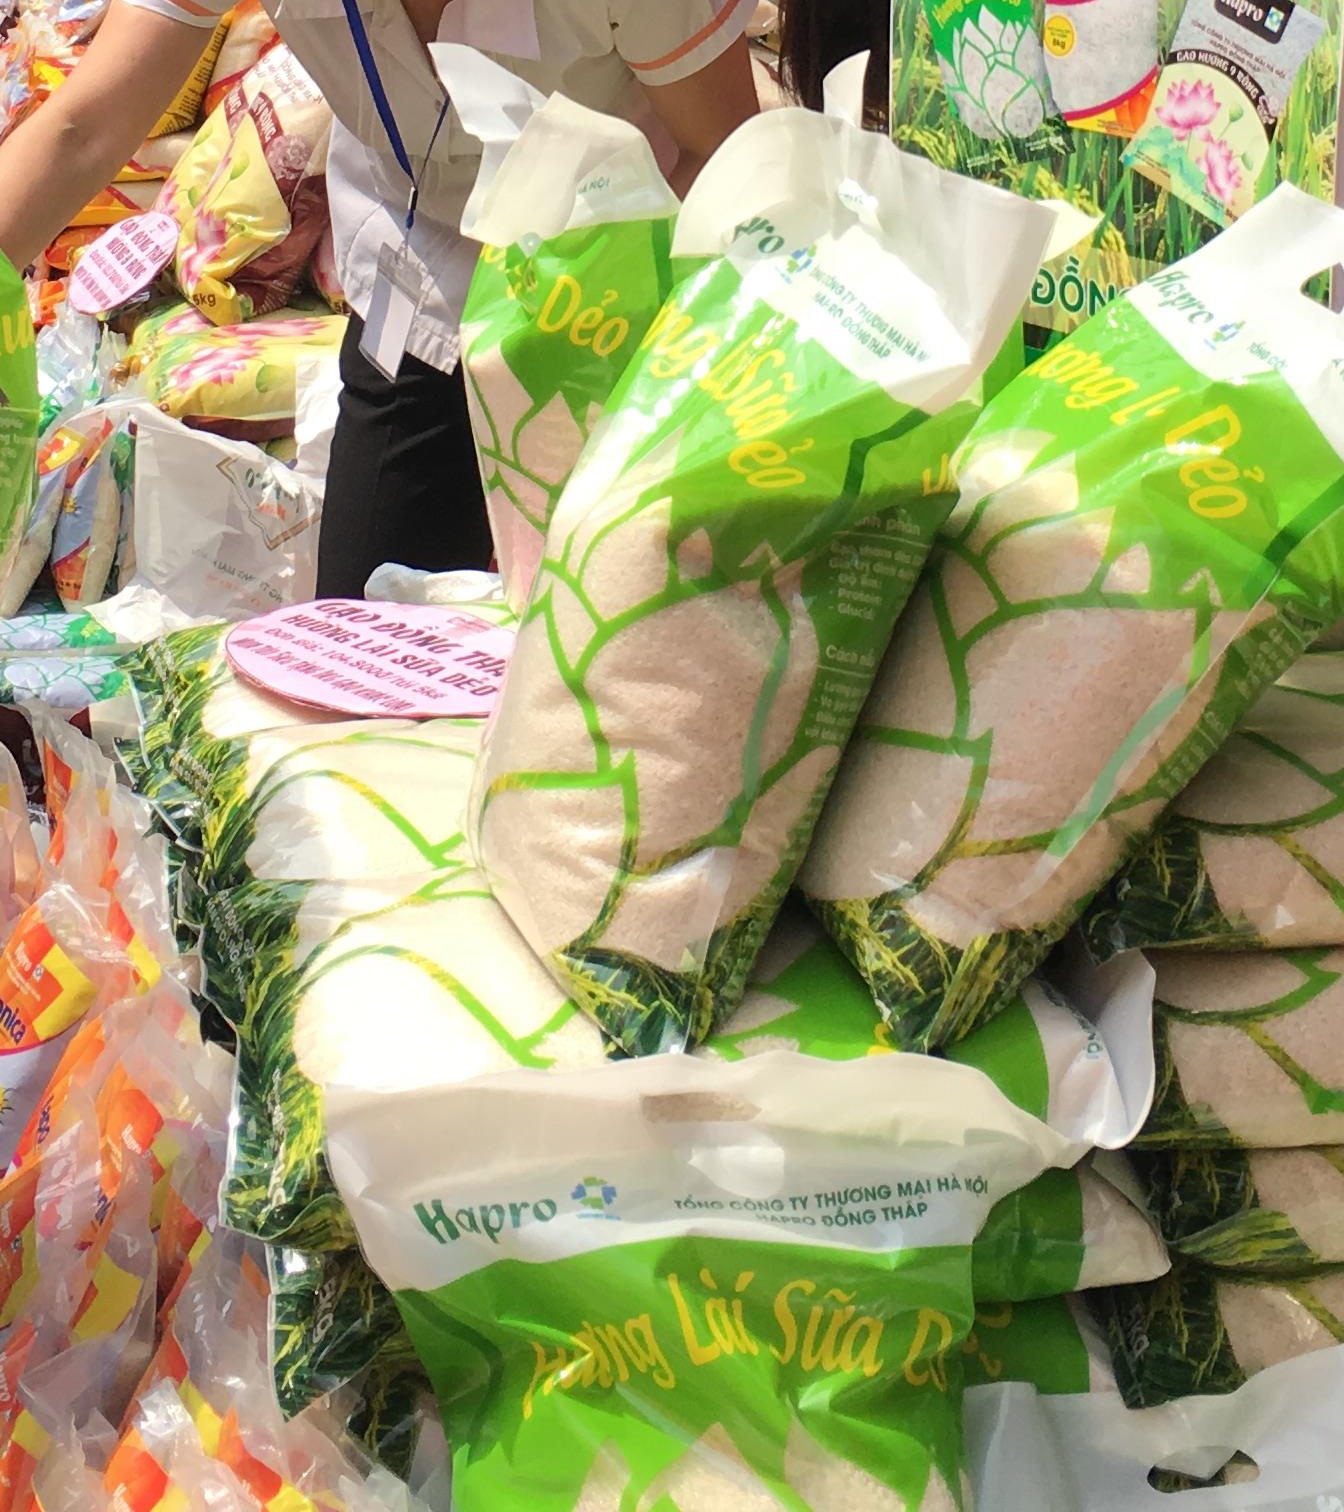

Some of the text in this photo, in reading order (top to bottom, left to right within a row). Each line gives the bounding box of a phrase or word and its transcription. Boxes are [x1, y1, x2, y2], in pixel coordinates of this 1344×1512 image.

[1030, 256, 1136, 317] ĐỒN
[537, 274, 629, 357] Dẻo
[728, 437, 815, 489] ẻo
[1164, 404, 1266, 519] Dẻo
[314, 602, 382, 624] GẠO
[370, 621, 464, 654] ĐỒNG
[413, 1192, 559, 1245] Hapro
[729, 1194, 785, 1213] CÔNG
[788, 1193, 809, 1211] TY
[813, 1183, 893, 1209] THƯƠNG
[897, 1177, 933, 1203] MẠI
[936, 1173, 962, 1194] HÀ
[821, 1205, 878, 1228] ĐỒNG
[882, 1199, 929, 1223] THÁP
[768, 1279, 886, 1377] Sữa
